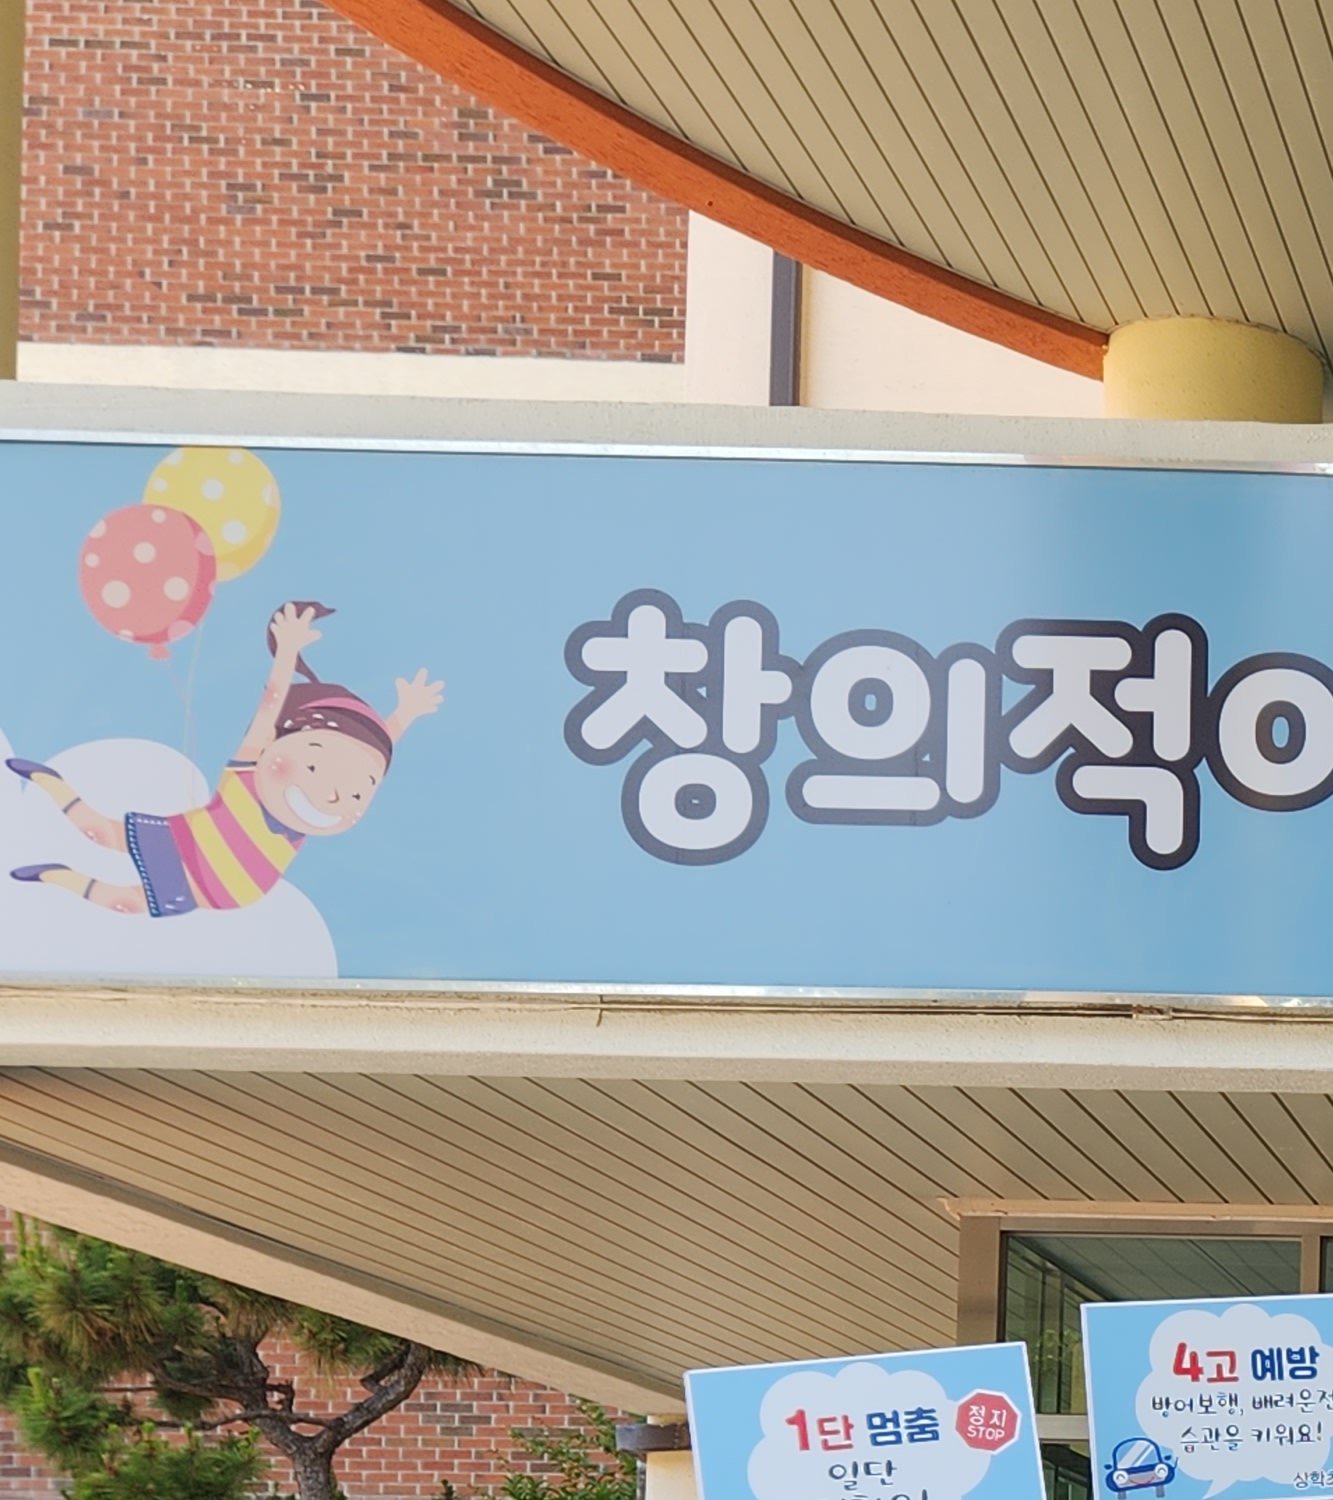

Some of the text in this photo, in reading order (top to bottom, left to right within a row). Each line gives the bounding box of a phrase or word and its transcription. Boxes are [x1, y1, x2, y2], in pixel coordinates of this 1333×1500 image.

[1172, 1342, 1319, 1384] 4고 예방
[786, 1406, 941, 1452] 1단 멈춤
[967, 1425, 1005, 1443] STOP
[1180, 1424, 1323, 1453] 습관을 키워요!
[828, 1459, 898, 1492] 일단
